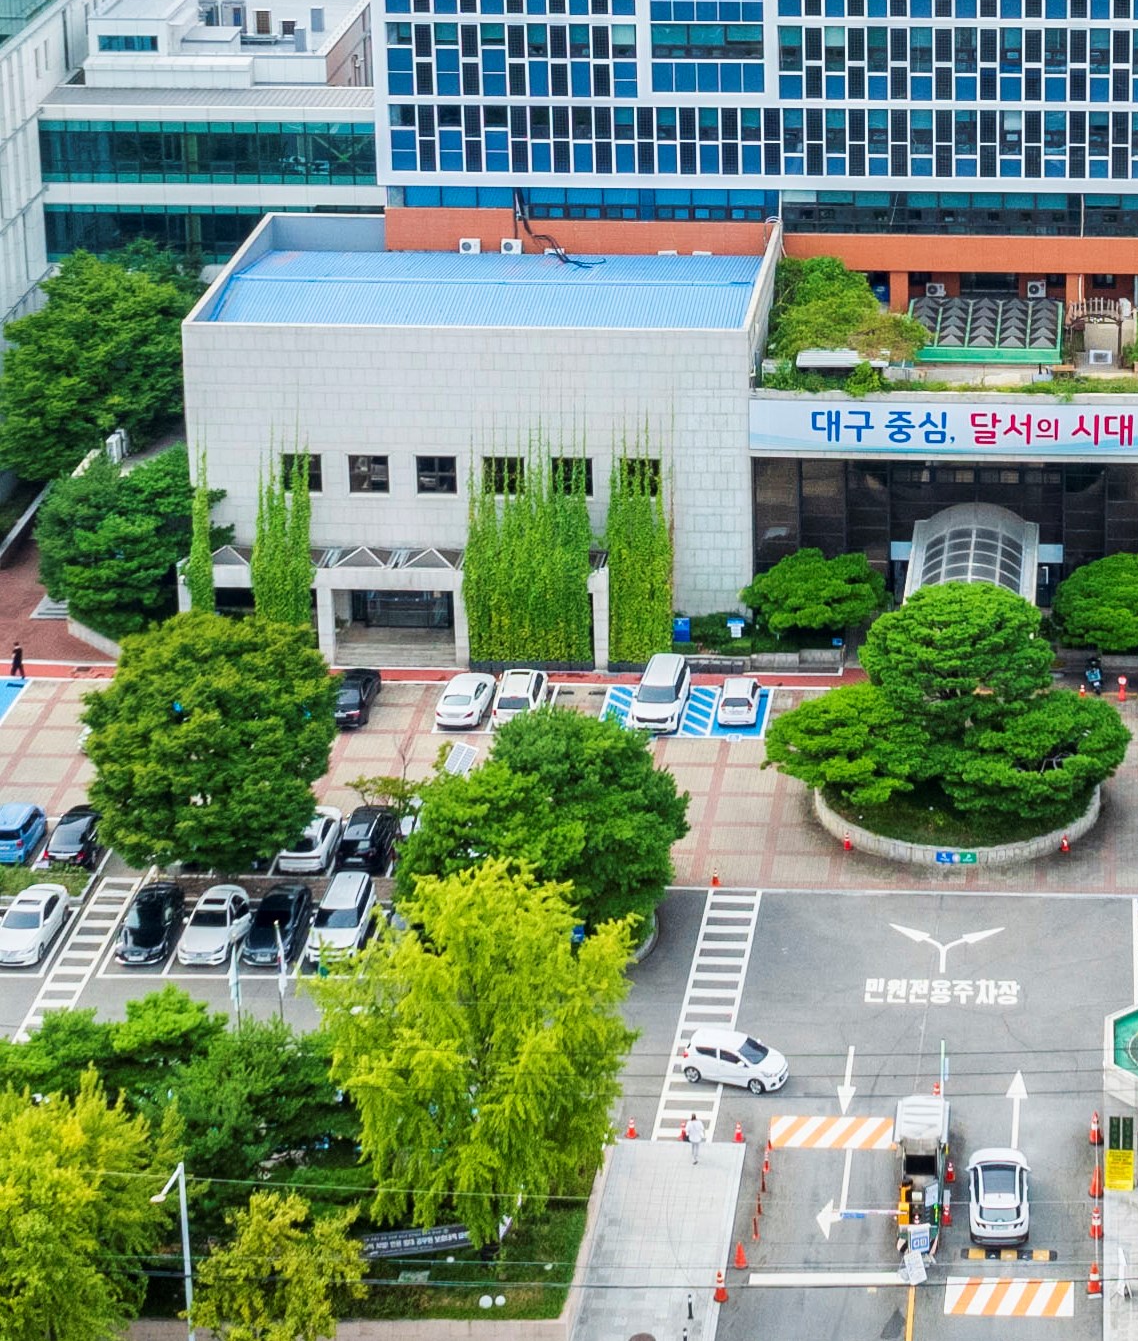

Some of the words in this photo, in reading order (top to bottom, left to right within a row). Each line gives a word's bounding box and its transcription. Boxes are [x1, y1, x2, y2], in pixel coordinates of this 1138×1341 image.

[811, 410, 875, 443] 대구
[884, 411, 955, 444] 중심,
[970, 413, 1059, 445] 달서의
[1071, 414, 1134, 446] 시대
[864, 978, 1021, 1005] 민원전용주차장
